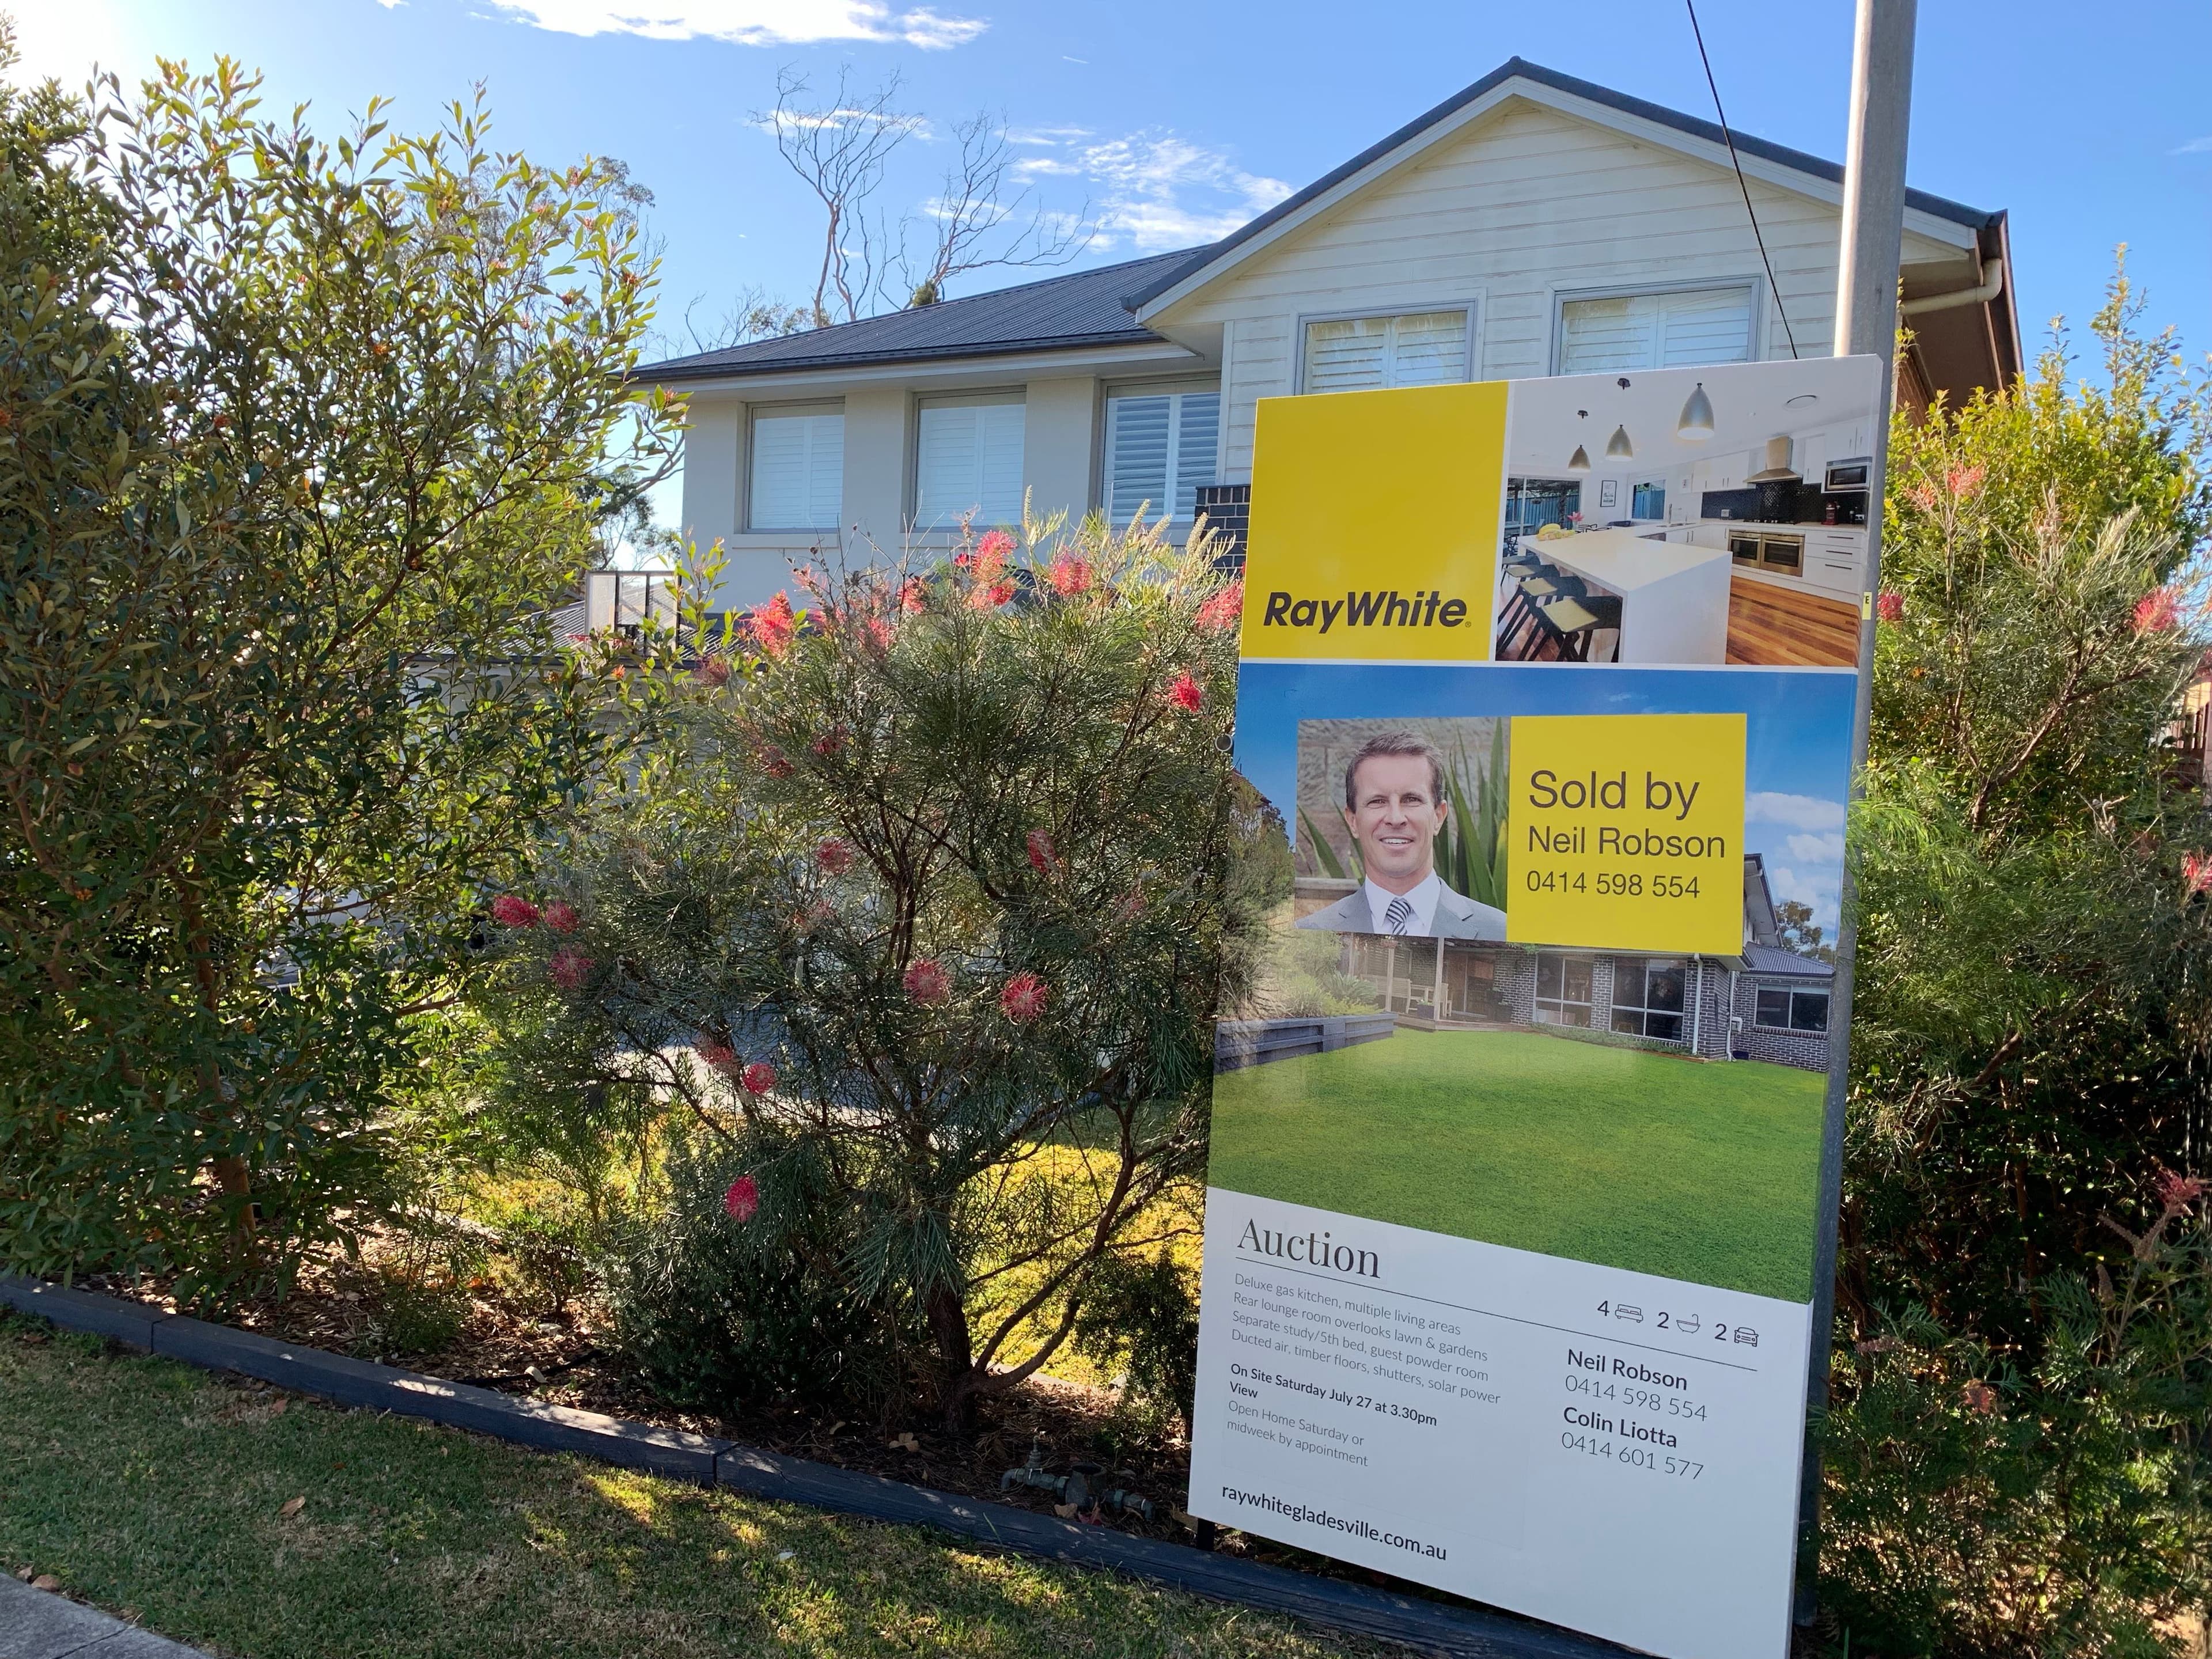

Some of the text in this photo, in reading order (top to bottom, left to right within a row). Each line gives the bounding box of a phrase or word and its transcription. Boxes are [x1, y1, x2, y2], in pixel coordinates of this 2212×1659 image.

[1529, 770, 1700, 820] Sold by
[1528, 825, 1725, 858] Neil Robson
[1527, 870, 1700, 898] 0414 598 554
[1237, 1218, 1380, 1278] Auction
[1234, 1292, 1487, 1361] Rear lounge room overlooks lawn & gardens
[1236, 1273, 1460, 1335] Deluxe gas kitchen, multiple living areas
[1597, 1301, 1726, 1341] 4 2 2
[1232, 1329, 1501, 1404] Ducted air, timber floors, shutters, solar power
[1233, 1310, 1488, 1381] Separate study/5th bed, guest powder room
[1230, 1381, 1258, 1398] View
[1568, 1349, 1687, 1391] Neil Robson
[1231, 1363, 1437, 1426] On Site Saturday July 27 at 3.30pm
[1566, 1375, 1707, 1422] 0414 598 554
[1228, 1421, 1368, 1467] midweek by appointment
[1229, 1400, 1364, 1446] Open Home Saturday or
[1564, 1407, 1676, 1448] Colin Liotta
[1562, 1432, 1704, 1479] 0414 601 577
[1222, 1487, 1446, 1560] raywhitegladesville.com.au
